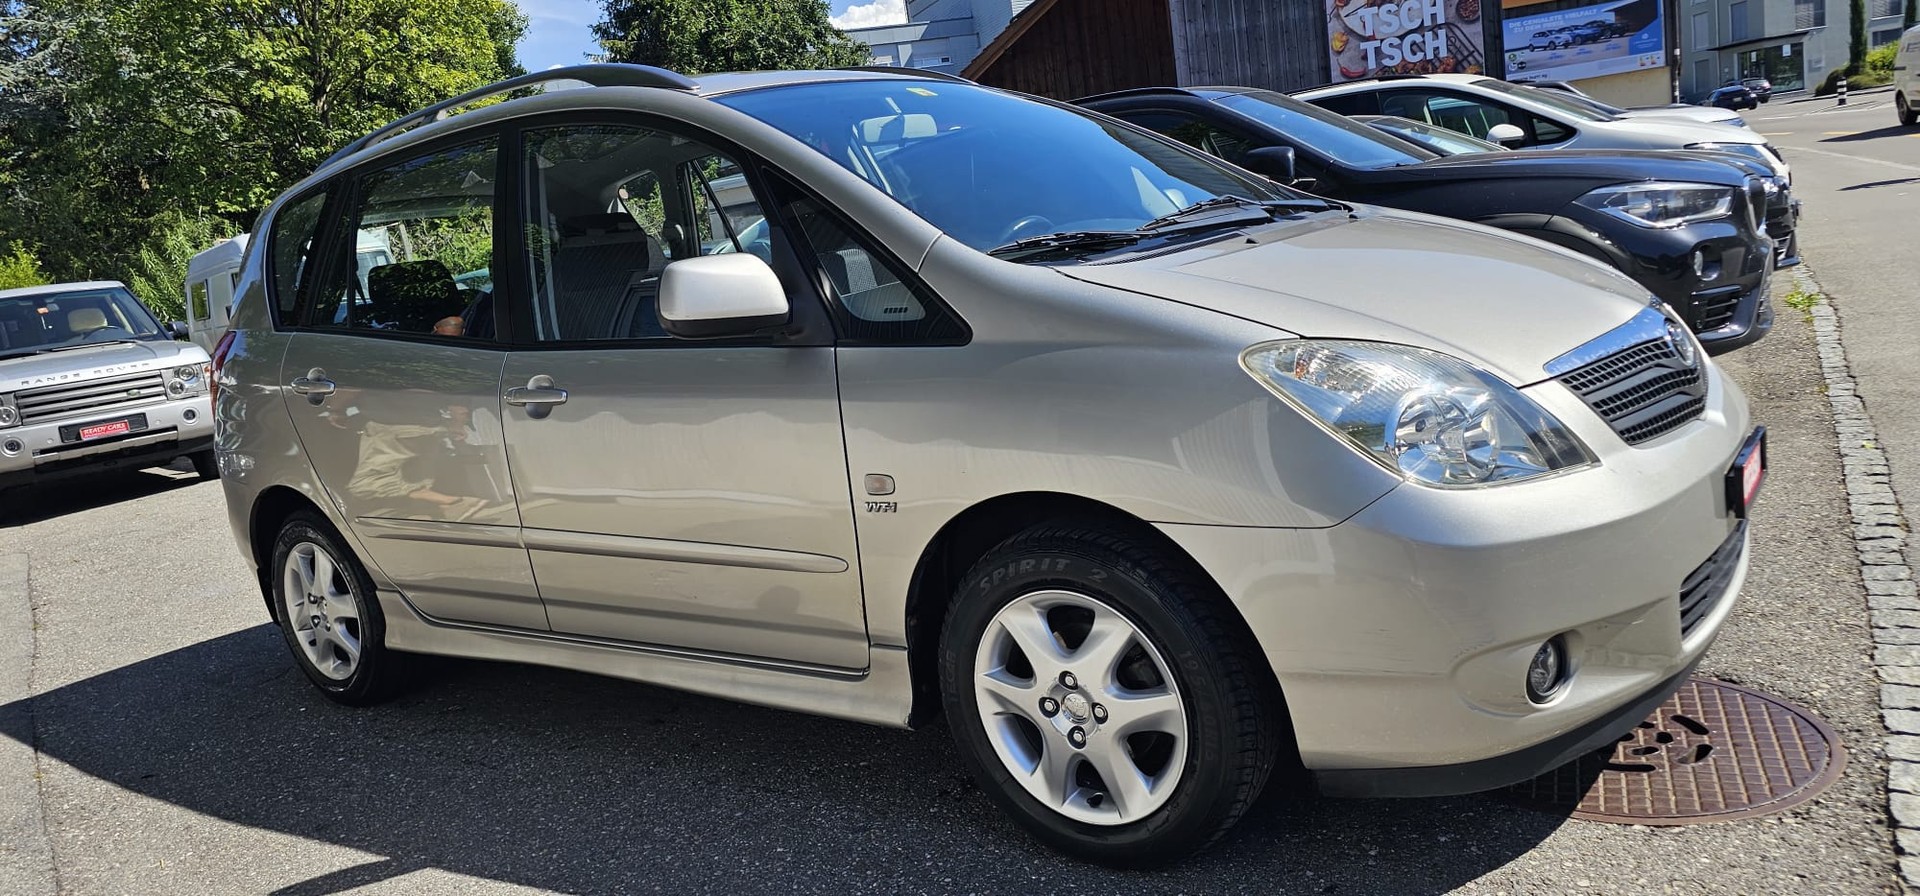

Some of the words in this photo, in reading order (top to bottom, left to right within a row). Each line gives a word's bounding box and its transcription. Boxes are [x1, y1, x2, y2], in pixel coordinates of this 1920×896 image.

[1358, 0, 1446, 37] TSCH
[1509, 21, 1521, 29] DIE
[1360, 28, 1448, 70] TSCH
[21, 372, 80, 386] RANGE
[94, 362, 150, 375] ROVER
[84, 425, 107, 435] READY
[108, 422, 126, 431] CARS
[979, 557, 1071, 597] SPIRIT
[1087, 568, 1108, 582] 2
